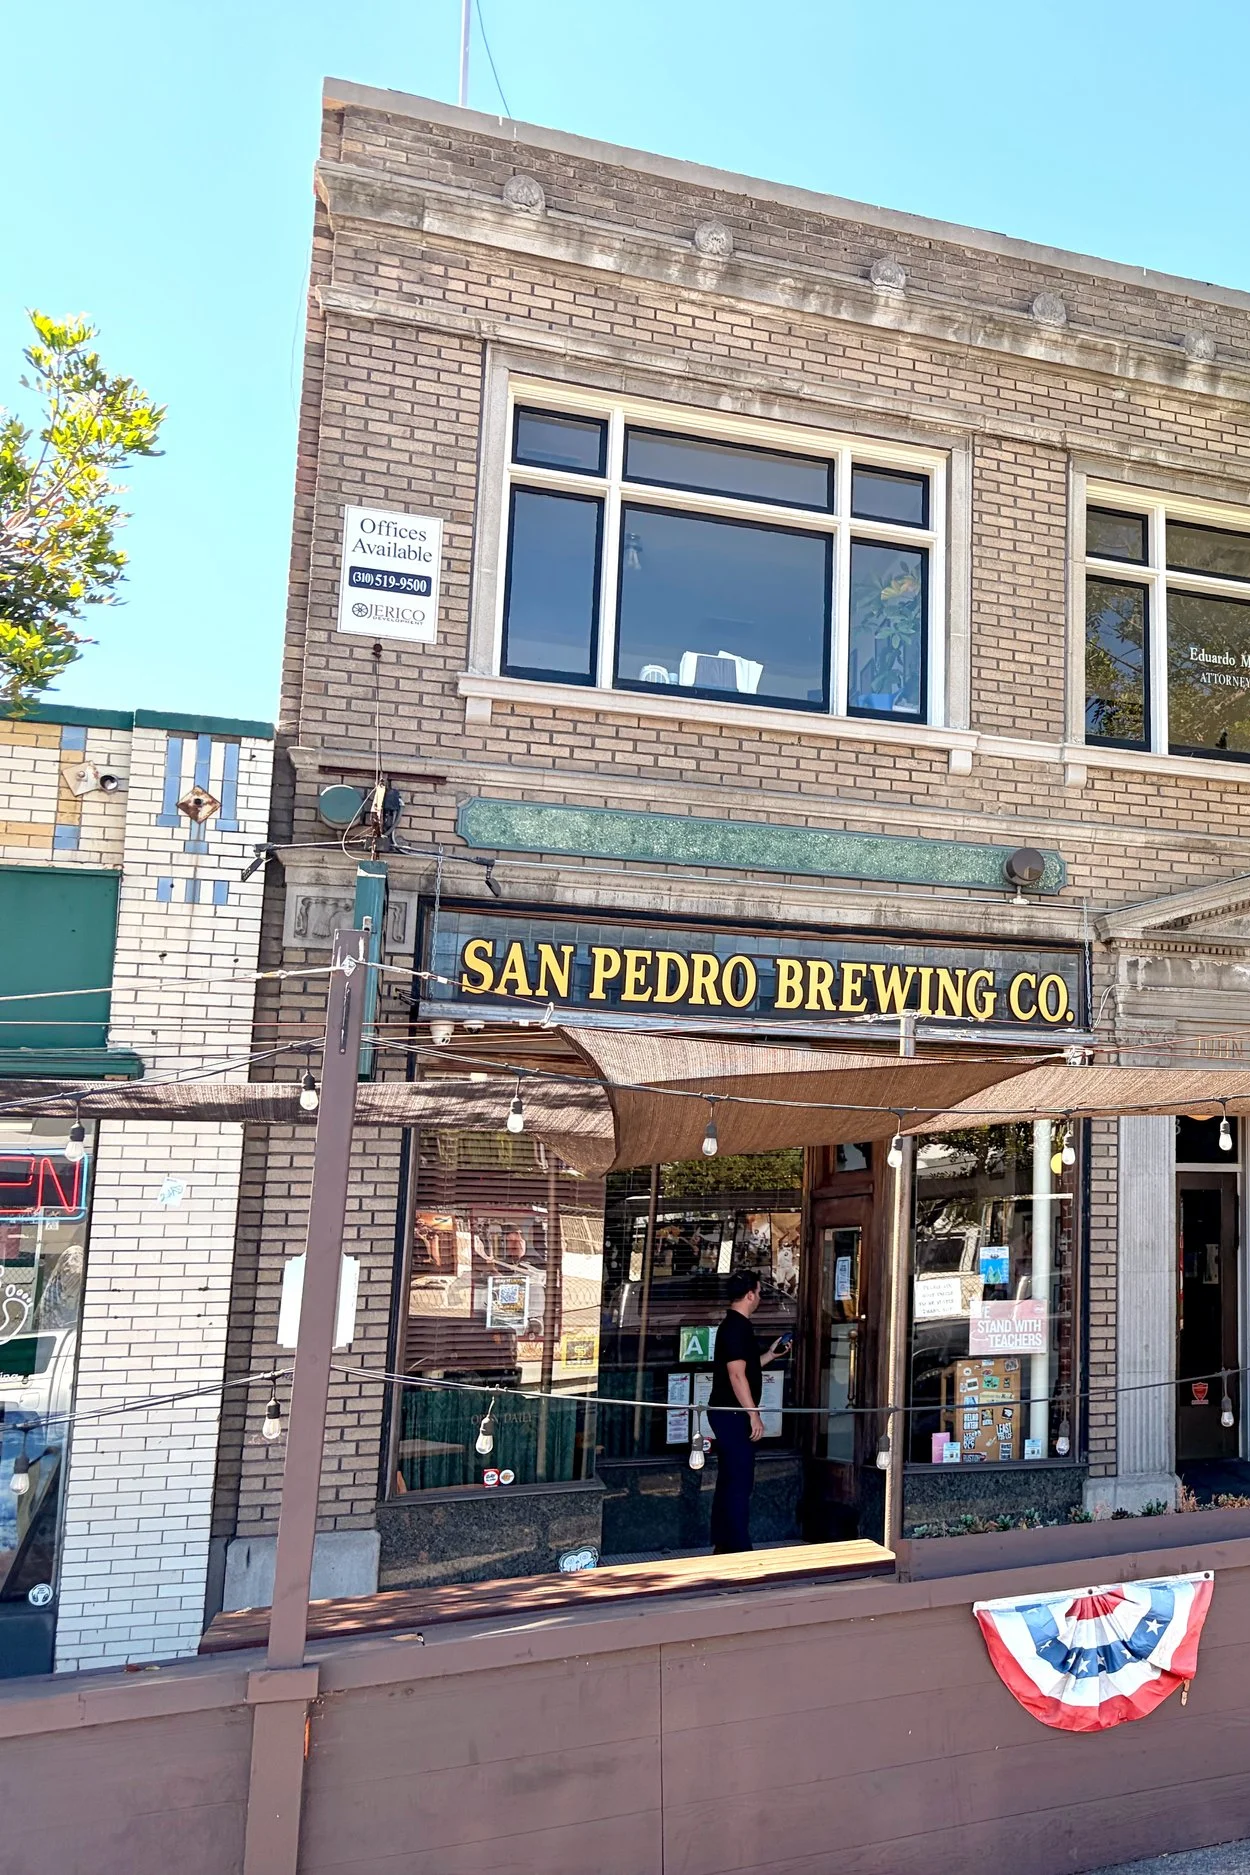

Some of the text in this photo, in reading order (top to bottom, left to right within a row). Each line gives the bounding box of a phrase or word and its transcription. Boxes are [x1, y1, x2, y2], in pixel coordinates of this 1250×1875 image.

[360, 518, 427, 542] Offices
[352, 538, 432, 563] Available
[353, 571, 427, 592] (310) 519-9500
[367, 603, 425, 622] JERICO
[1189, 647, 1236, 666] Eduardo
[461, 938, 1075, 1023] SAN PEDRO BREWING CO.
[977, 1319, 1041, 1333] STAND WITH
[685, 1335, 704, 1355] A
[988, 1334, 1042, 1347] TEACHERS
